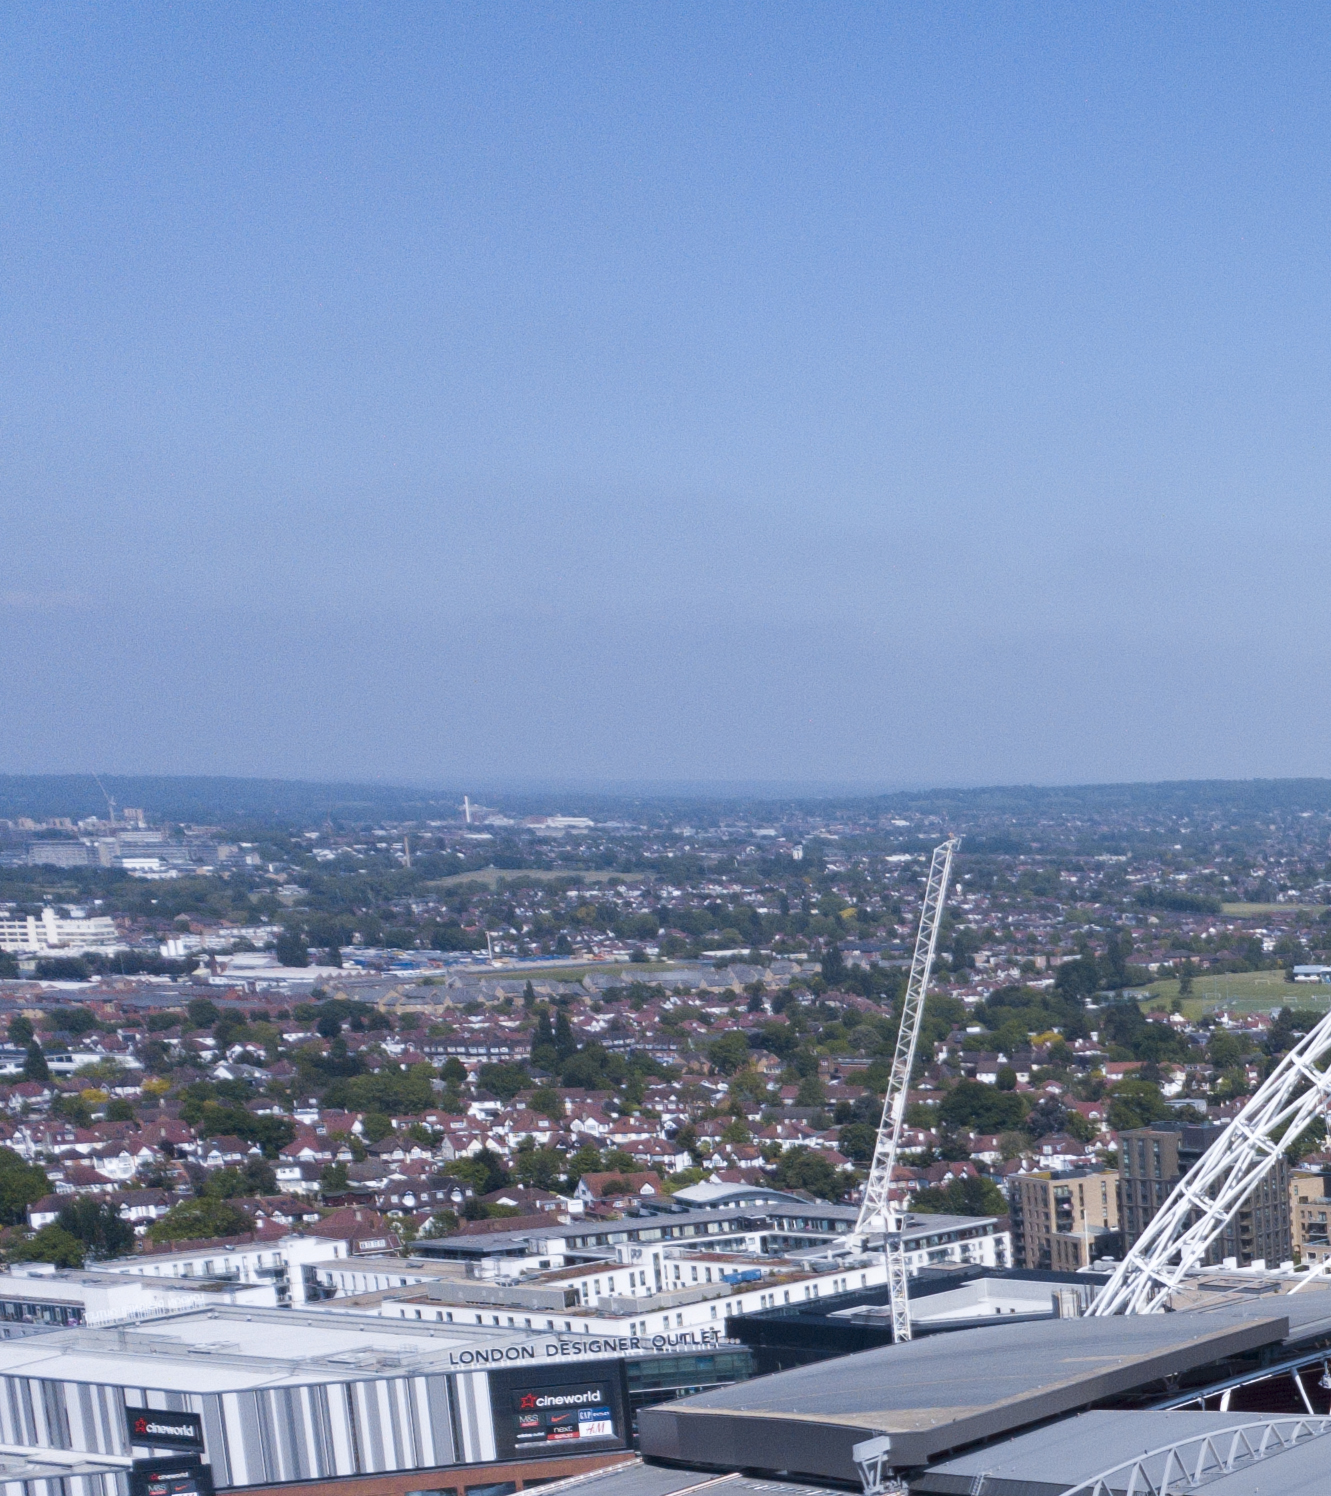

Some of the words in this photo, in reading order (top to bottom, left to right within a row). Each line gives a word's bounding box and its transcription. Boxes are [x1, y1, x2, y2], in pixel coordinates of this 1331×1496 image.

[449, 1345, 535, 1365] LONDON
[545, 1336, 641, 1357] DESIGNER
[651, 1330, 721, 1347] OUTLET
[536, 1390, 600, 1407] cineworld
[519, 1414, 538, 1423] M&S
[145, 1422, 195, 1437] cineworld
[157, 1471, 189, 1480] cineworld
[147, 1483, 167, 1492] M&S
